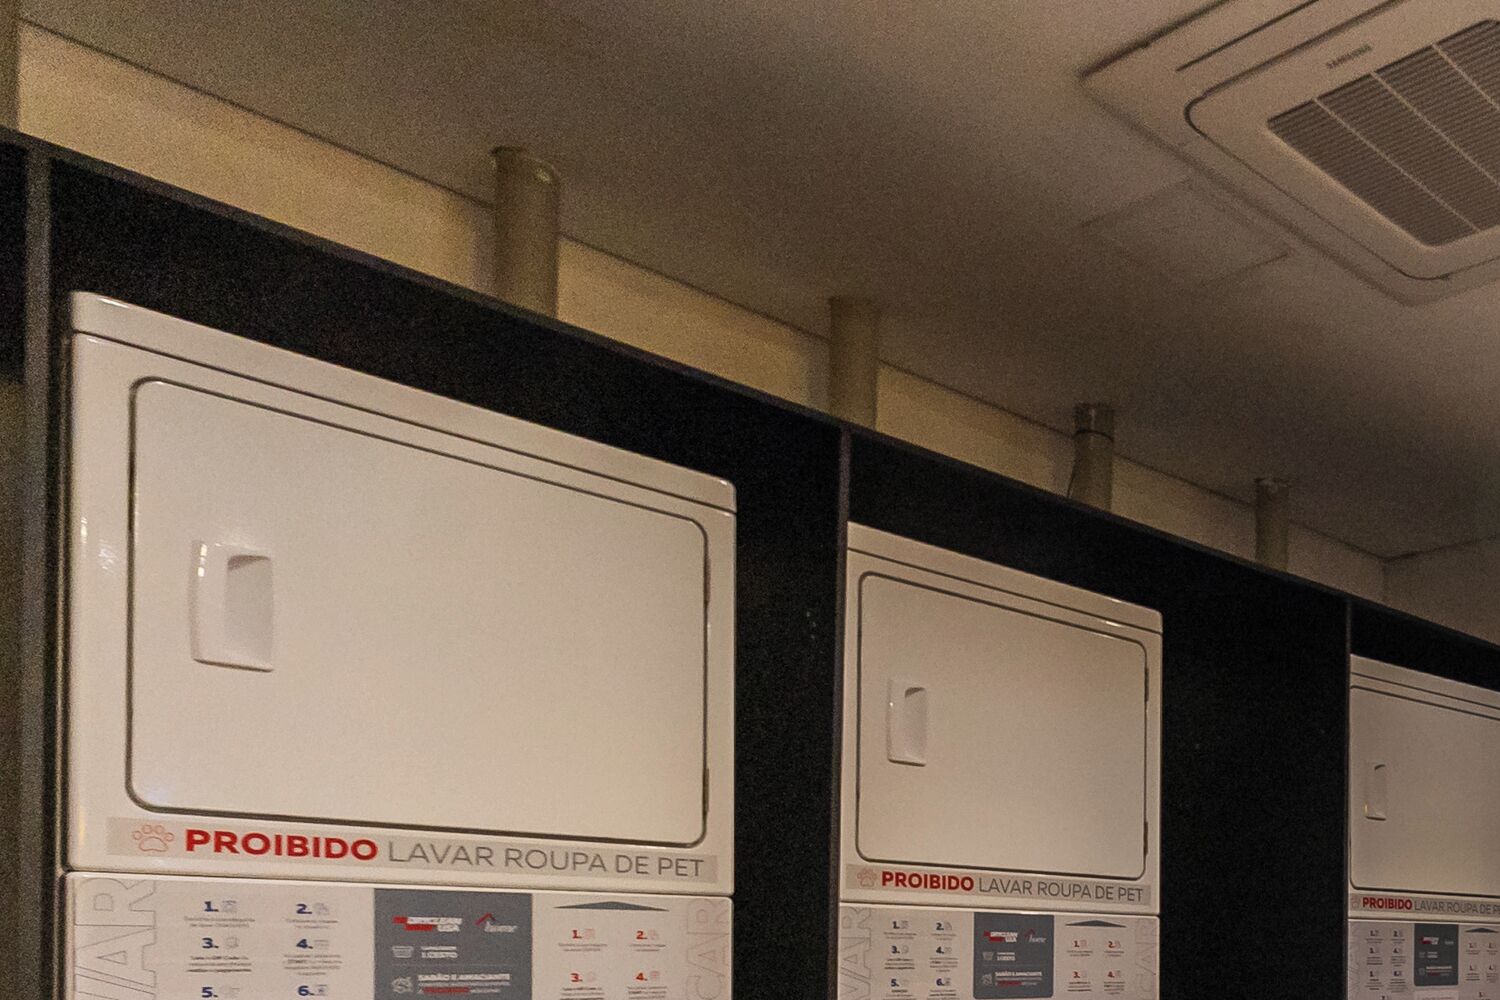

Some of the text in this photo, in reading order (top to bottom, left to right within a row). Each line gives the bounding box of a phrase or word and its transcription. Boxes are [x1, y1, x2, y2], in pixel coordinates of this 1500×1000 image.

[185, 829, 704, 878] PROIBIDO LAVAR ROUPA DE PET
[882, 871, 1143, 902] PROIBIDO LAVAR ROUPA DE PET
[204, 901, 219, 912] 1.
[296, 903, 312, 914] 2.
[1362, 896, 1413, 910] PROIBIDO
[1414, 900, 1445, 911] LAVAR
[1447, 902, 1478, 914] ROUPA
[1479, 904, 1491, 914] DE
[202, 937, 219, 949] 3.
[296, 939, 313, 949] 4.
[202, 987, 218, 998] 5.
[298, 985, 315, 996] 6.
